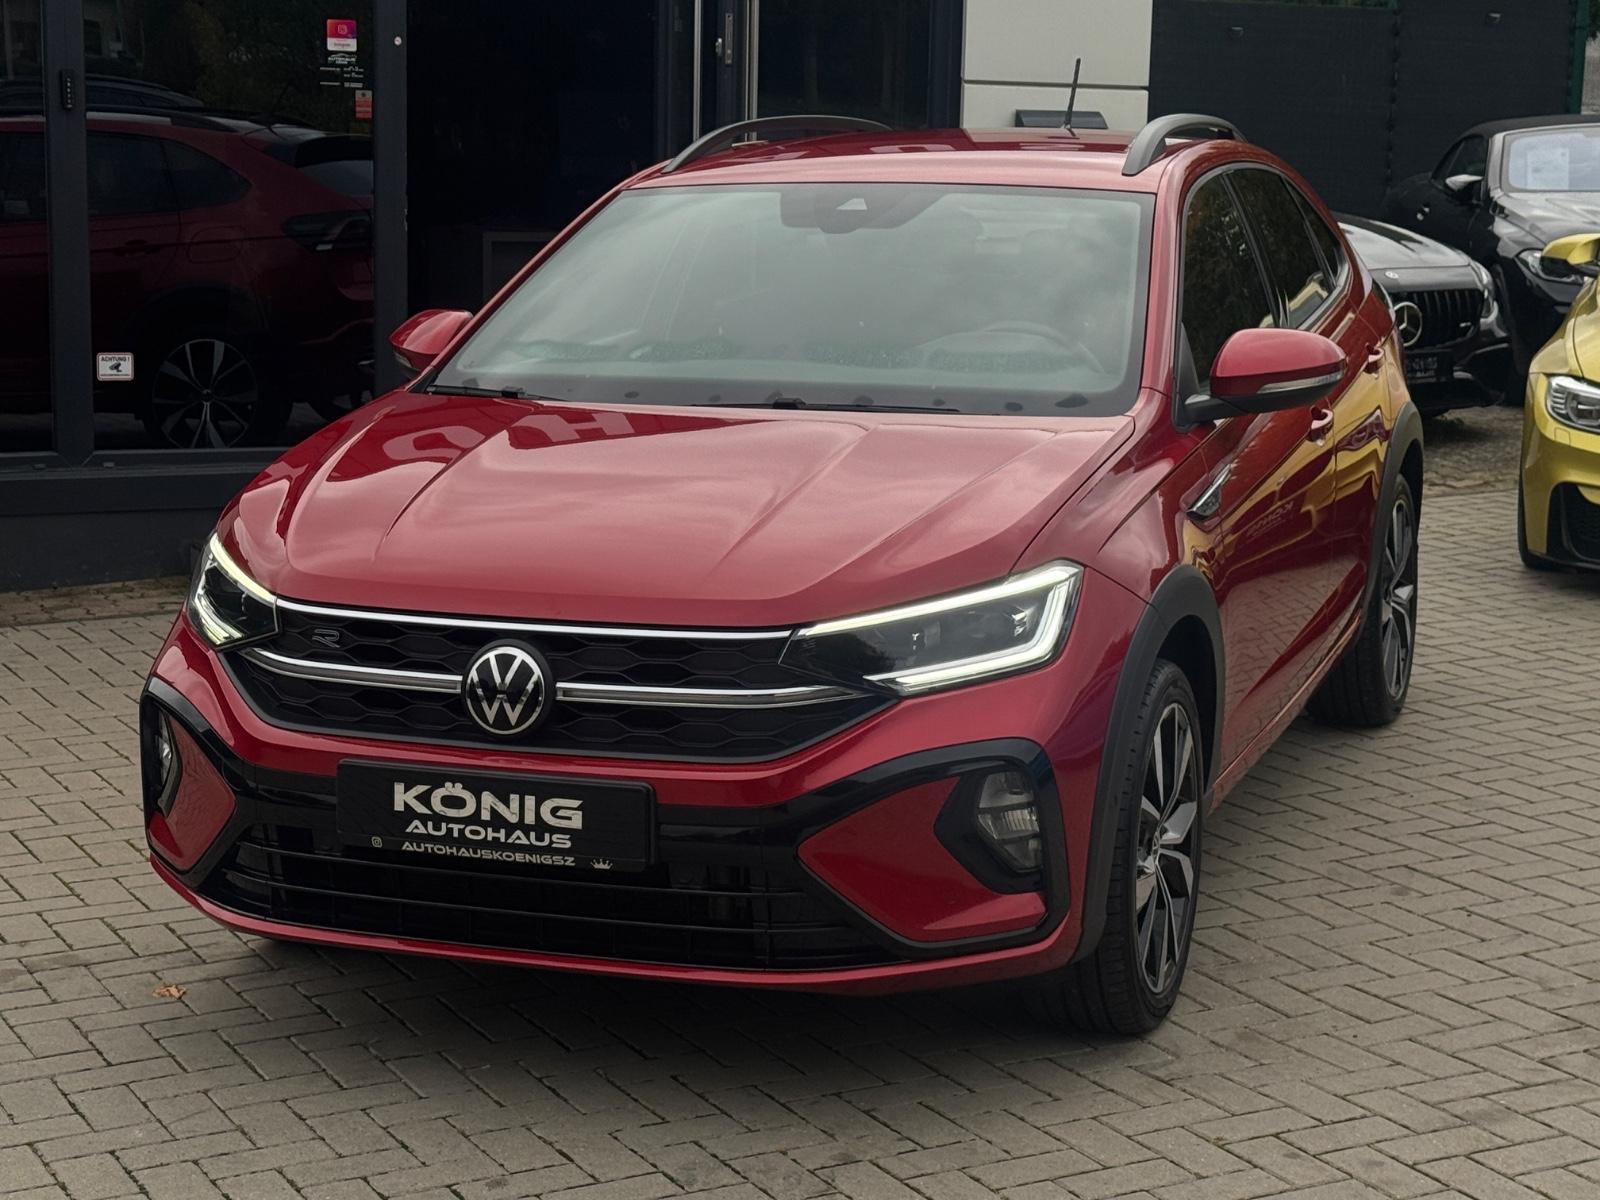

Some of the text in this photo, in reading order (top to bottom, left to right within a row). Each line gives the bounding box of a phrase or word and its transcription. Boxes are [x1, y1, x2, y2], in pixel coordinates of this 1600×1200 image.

[468, 647, 545, 734] VW
[393, 781, 582, 830] KÖNIG
[401, 841, 576, 866] AUTOHAUSKOENIGSZ
[405, 819, 572, 849] AUTOHAUS
